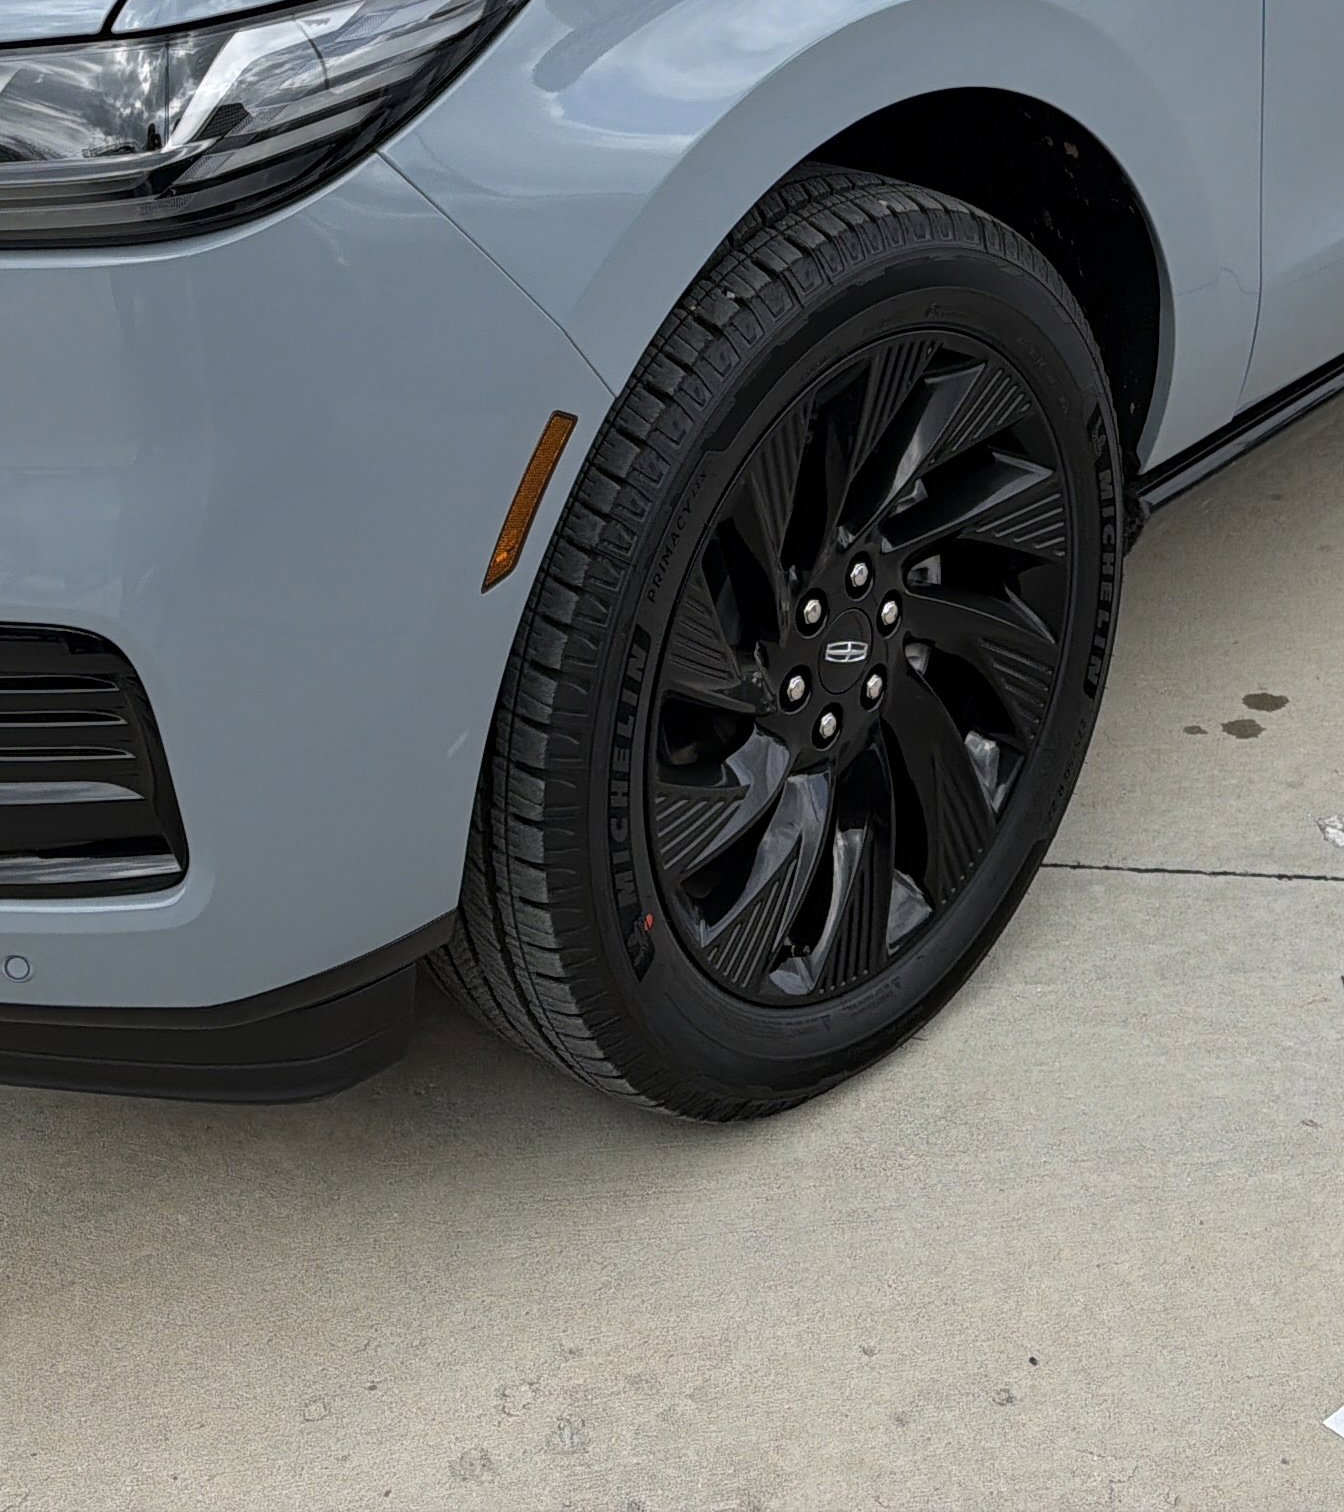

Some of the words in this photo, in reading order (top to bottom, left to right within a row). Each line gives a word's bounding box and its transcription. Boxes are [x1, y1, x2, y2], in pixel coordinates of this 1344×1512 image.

[647, 499, 692, 604] PRIMACY
[1088, 468, 1115, 686] MICHELIN
[610, 642, 648, 909] MICHELIN
